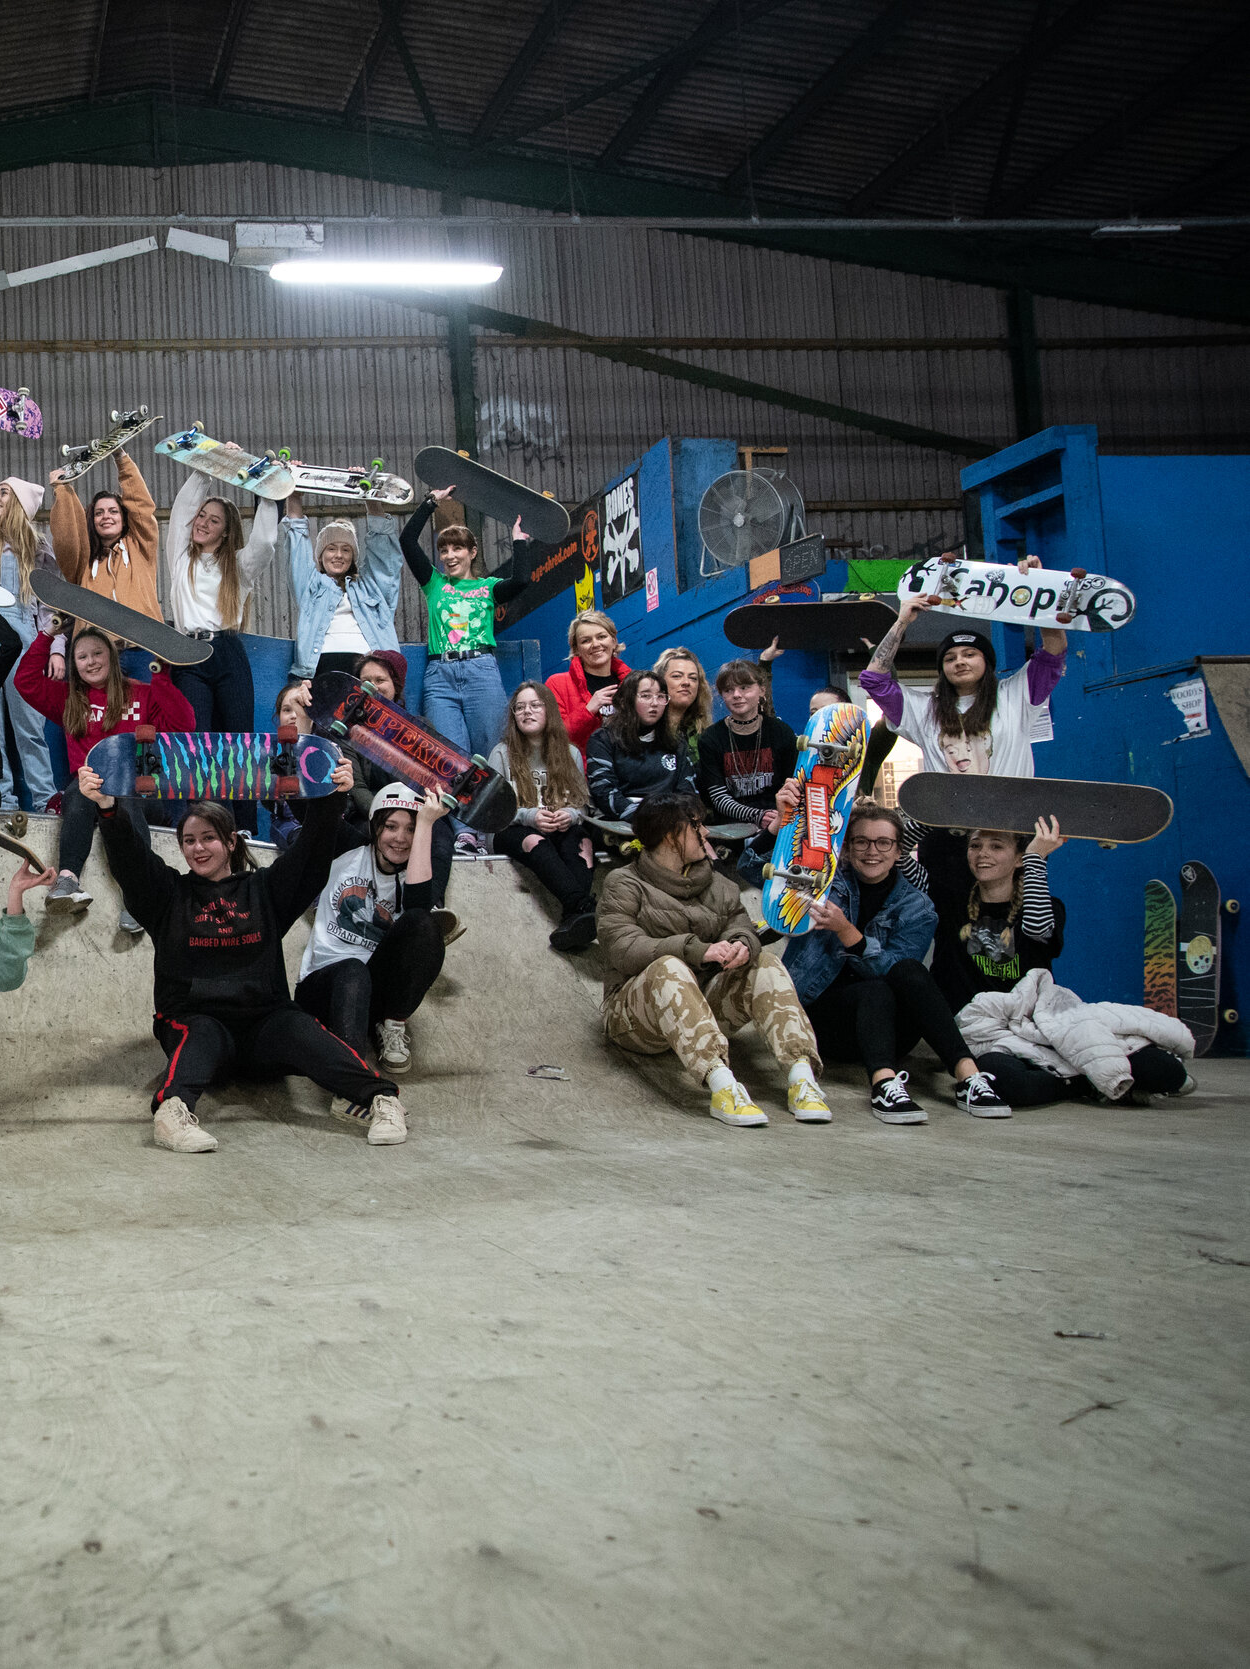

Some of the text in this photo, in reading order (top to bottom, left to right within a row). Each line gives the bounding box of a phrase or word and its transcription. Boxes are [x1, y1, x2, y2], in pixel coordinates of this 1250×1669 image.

[605, 477, 635, 523] BONES
[783, 550, 819, 573] OPEN
[1182, 699, 1202, 711] SHOP
[810, 786, 829, 850] TONY HAWK
[189, 931, 262, 947] BARBED WIRE SOULS
[218, 926, 233, 934] AND
[326, 922, 358, 943] DISTANT
